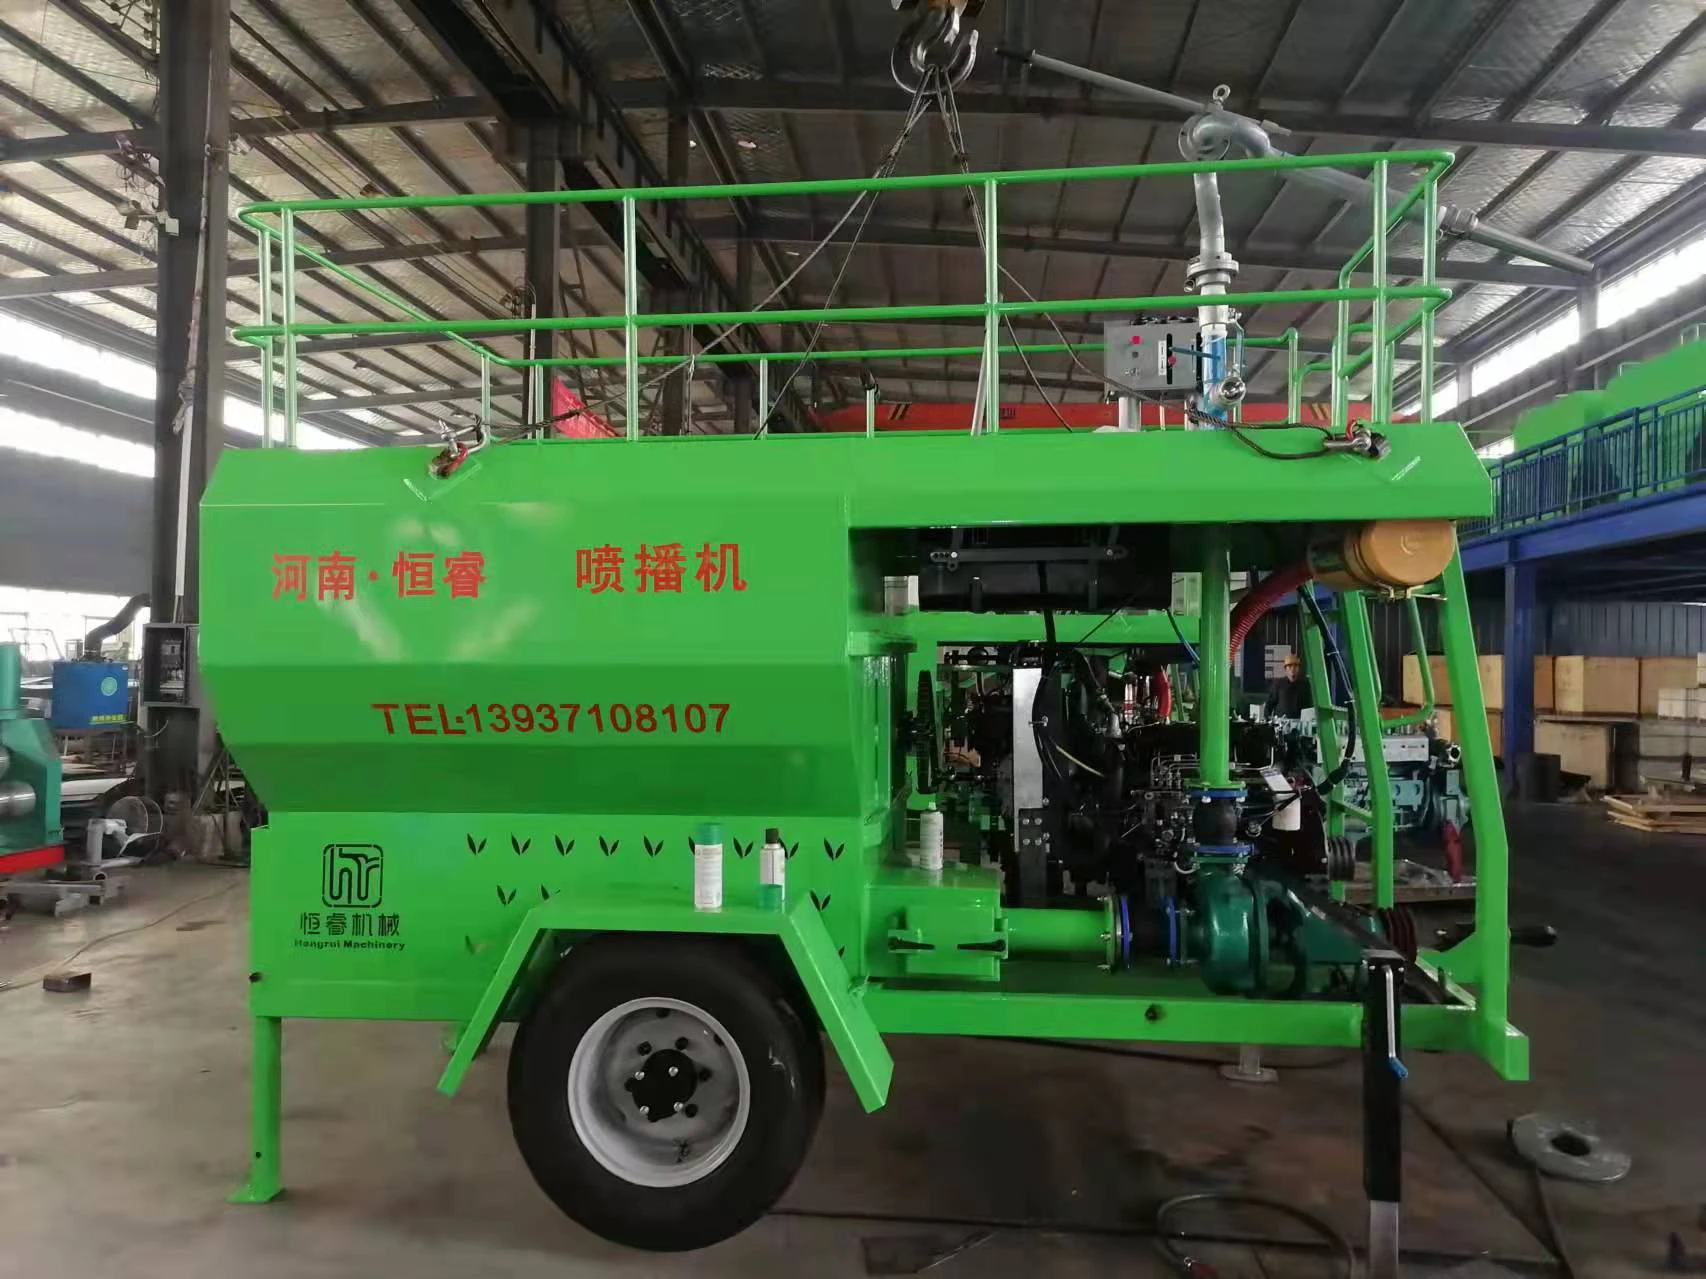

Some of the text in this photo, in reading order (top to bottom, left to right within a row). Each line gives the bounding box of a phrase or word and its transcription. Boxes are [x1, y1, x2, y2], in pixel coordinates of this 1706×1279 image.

[575, 542, 748, 595] 喷播机
[300, 912, 400, 937] 恒睿机械
